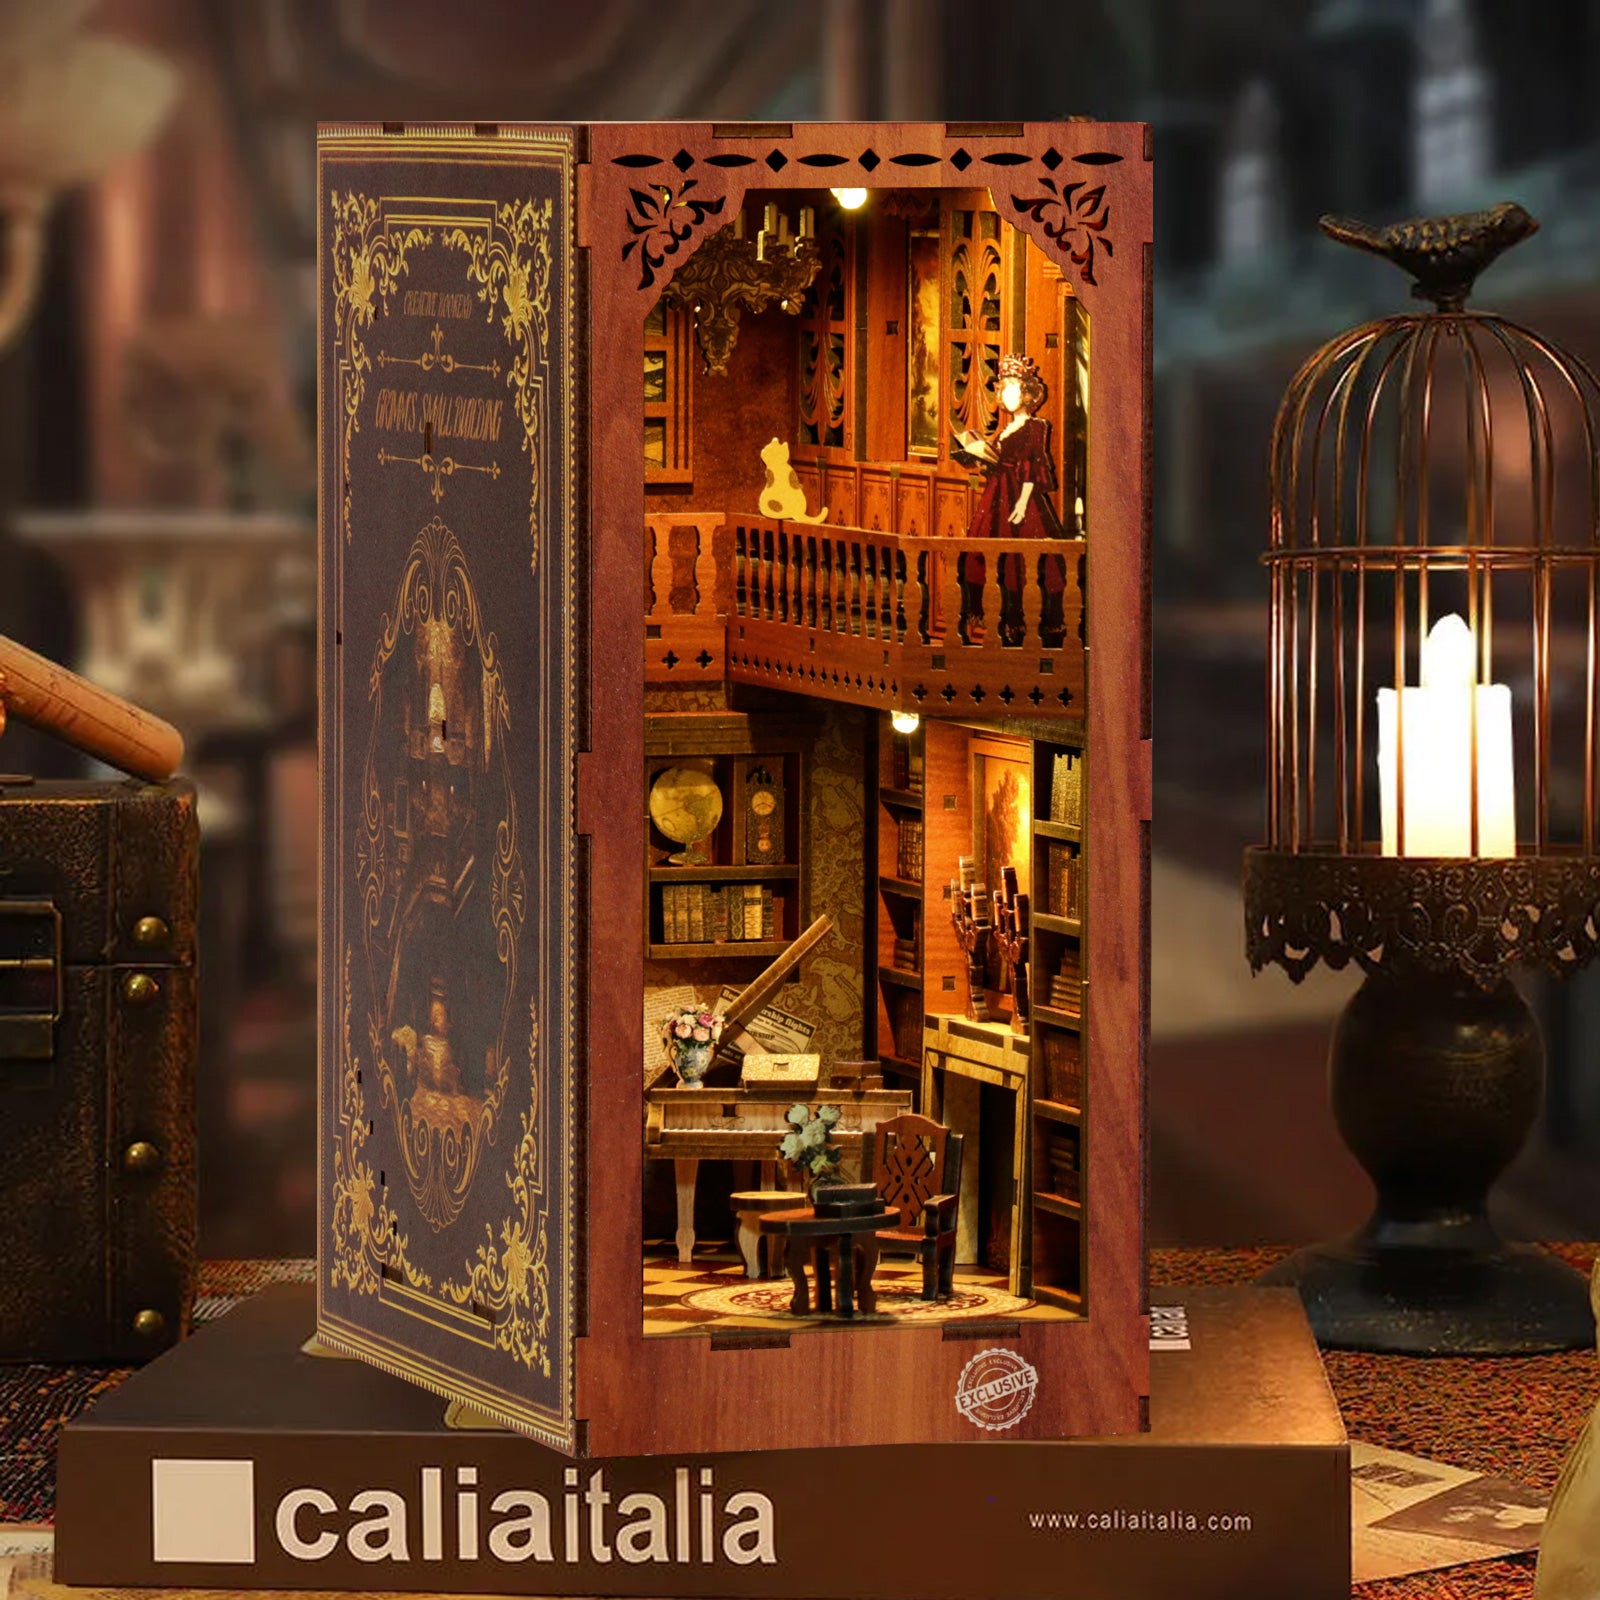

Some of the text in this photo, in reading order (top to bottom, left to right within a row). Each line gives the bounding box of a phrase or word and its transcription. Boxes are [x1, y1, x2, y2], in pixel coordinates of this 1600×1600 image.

[959, 1370, 1034, 1409] EXCLUSIVE
[275, 1466, 777, 1564] caliaitalia
[1029, 1510, 1252, 1531] www.caliaitalia.com
